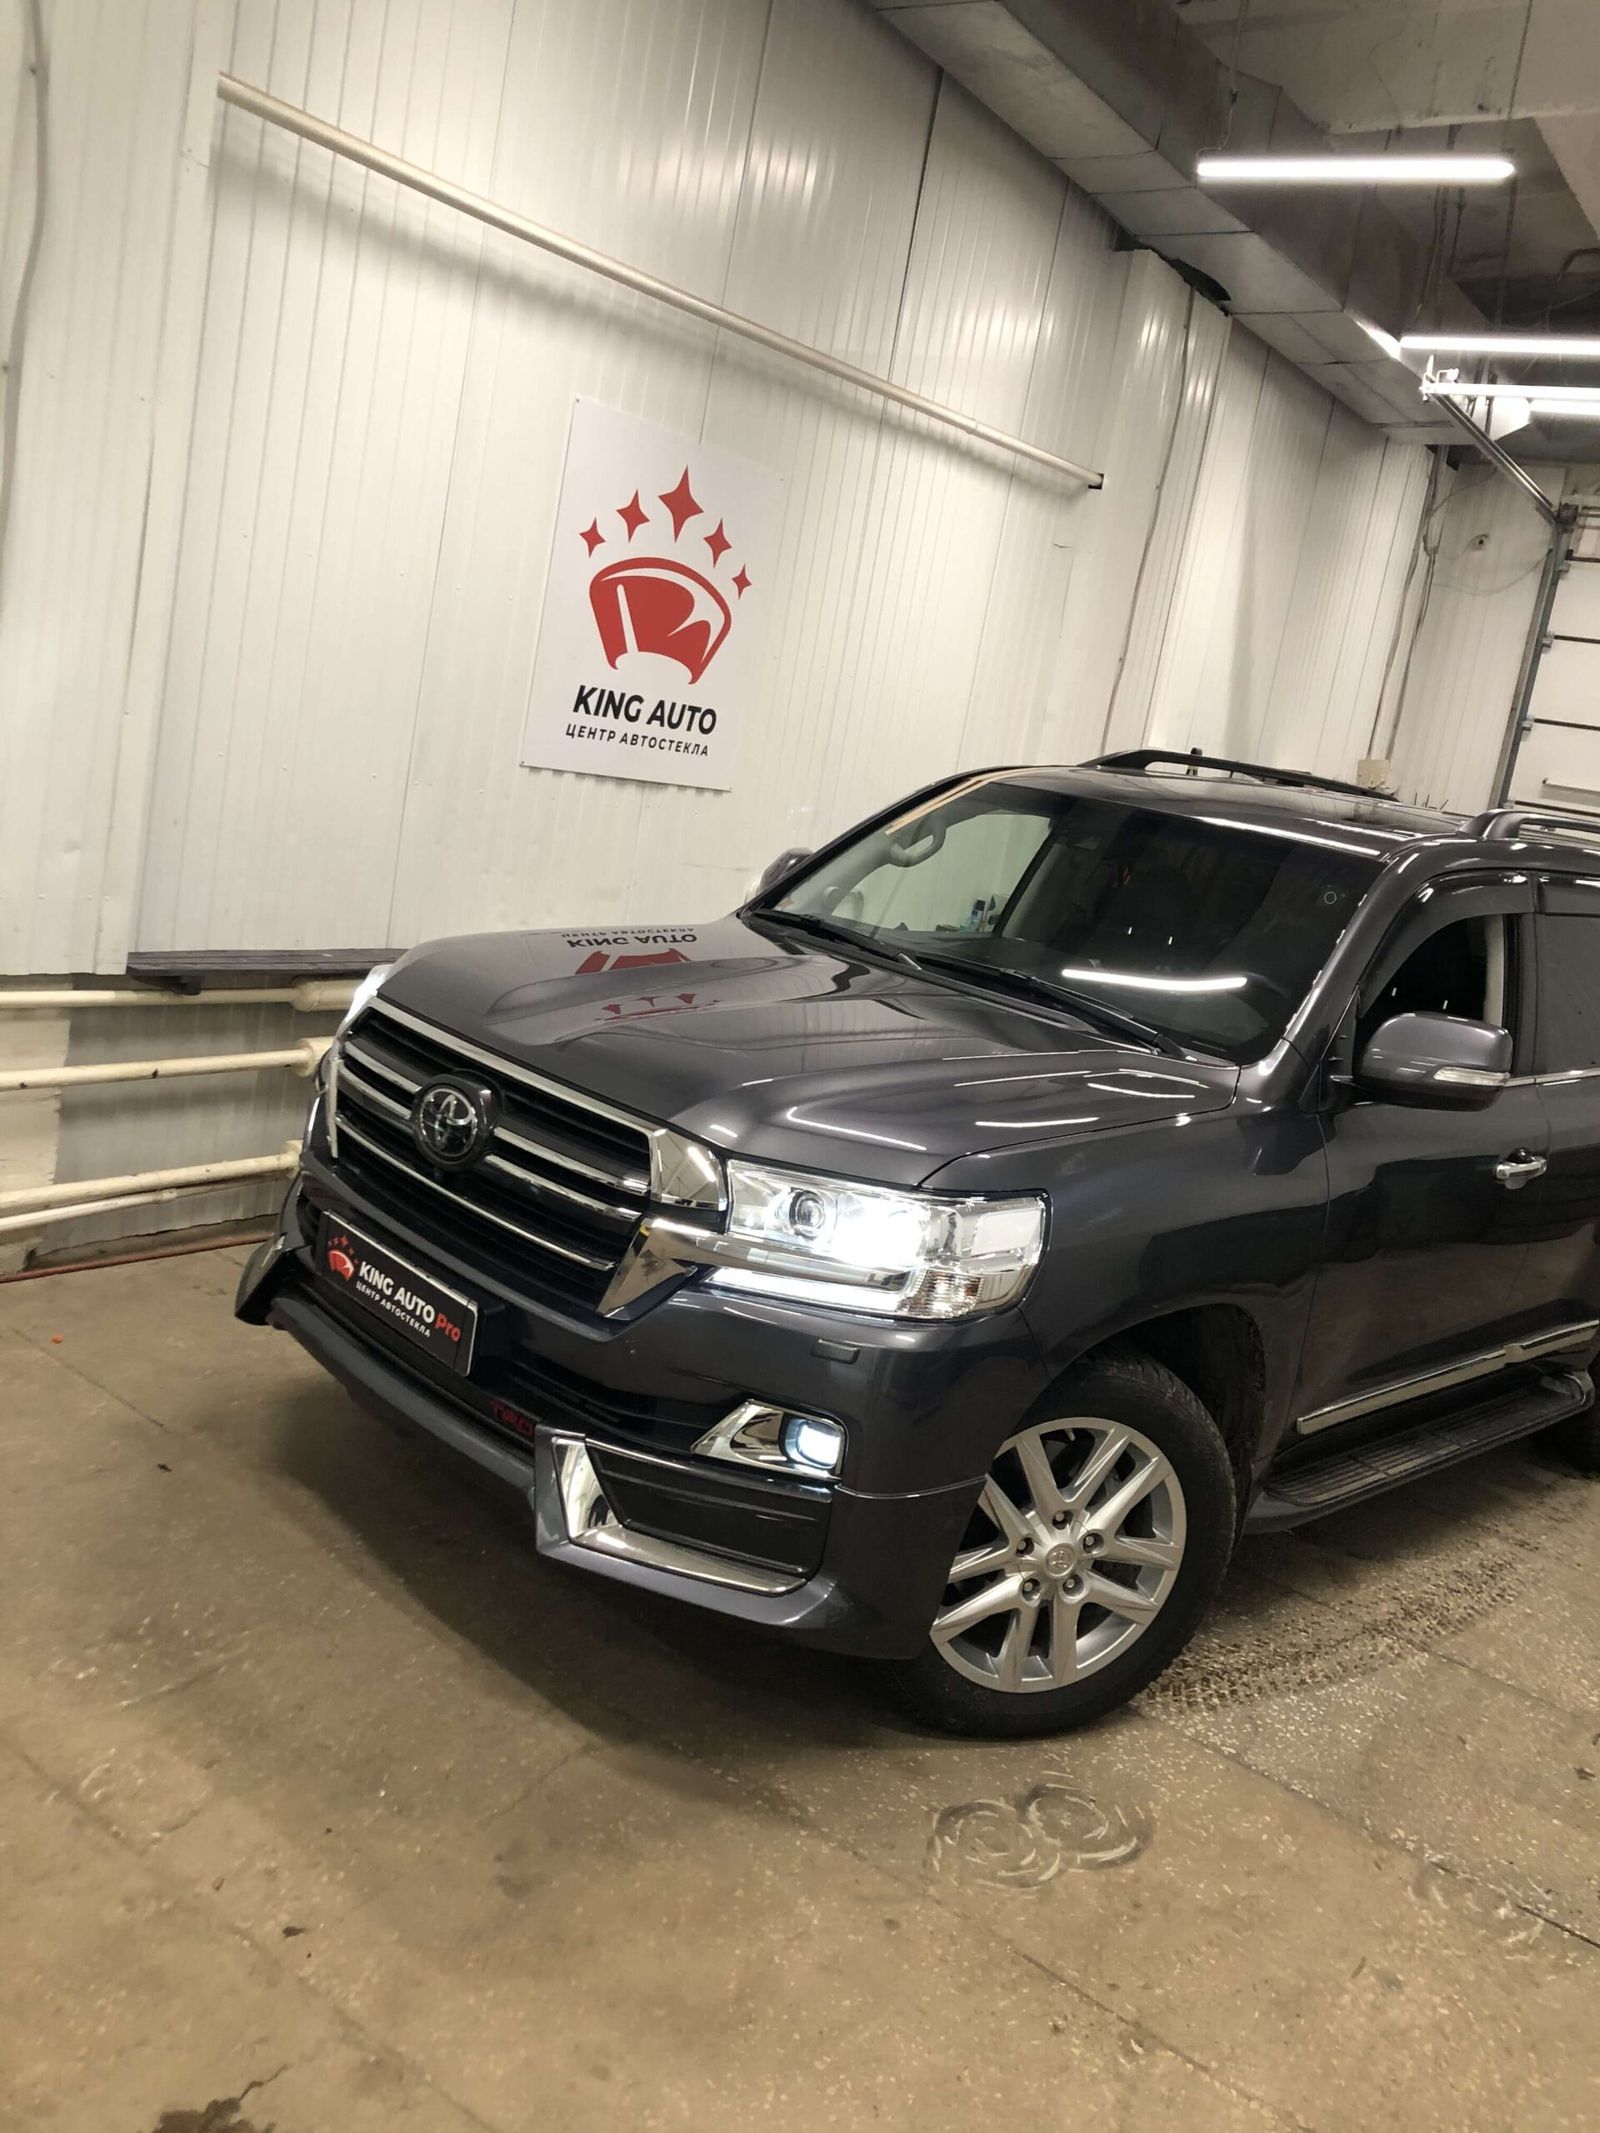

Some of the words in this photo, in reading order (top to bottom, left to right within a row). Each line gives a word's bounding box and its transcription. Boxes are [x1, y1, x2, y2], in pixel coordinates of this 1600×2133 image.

[573, 685, 644, 723] KING
[646, 699, 717, 735] AUTO
[565, 723, 616, 744] ЦЕНТР
[619, 732, 709, 757] АВТОСТЕКЛА
[355, 1281, 381, 1302] ЦЕНТР
[380, 1300, 431, 1338] АВТОСТЕКЛА
[359, 1261, 394, 1296] KING
[393, 1286, 436, 1323] AUTO
[435, 1313, 461, 1342] Pro
